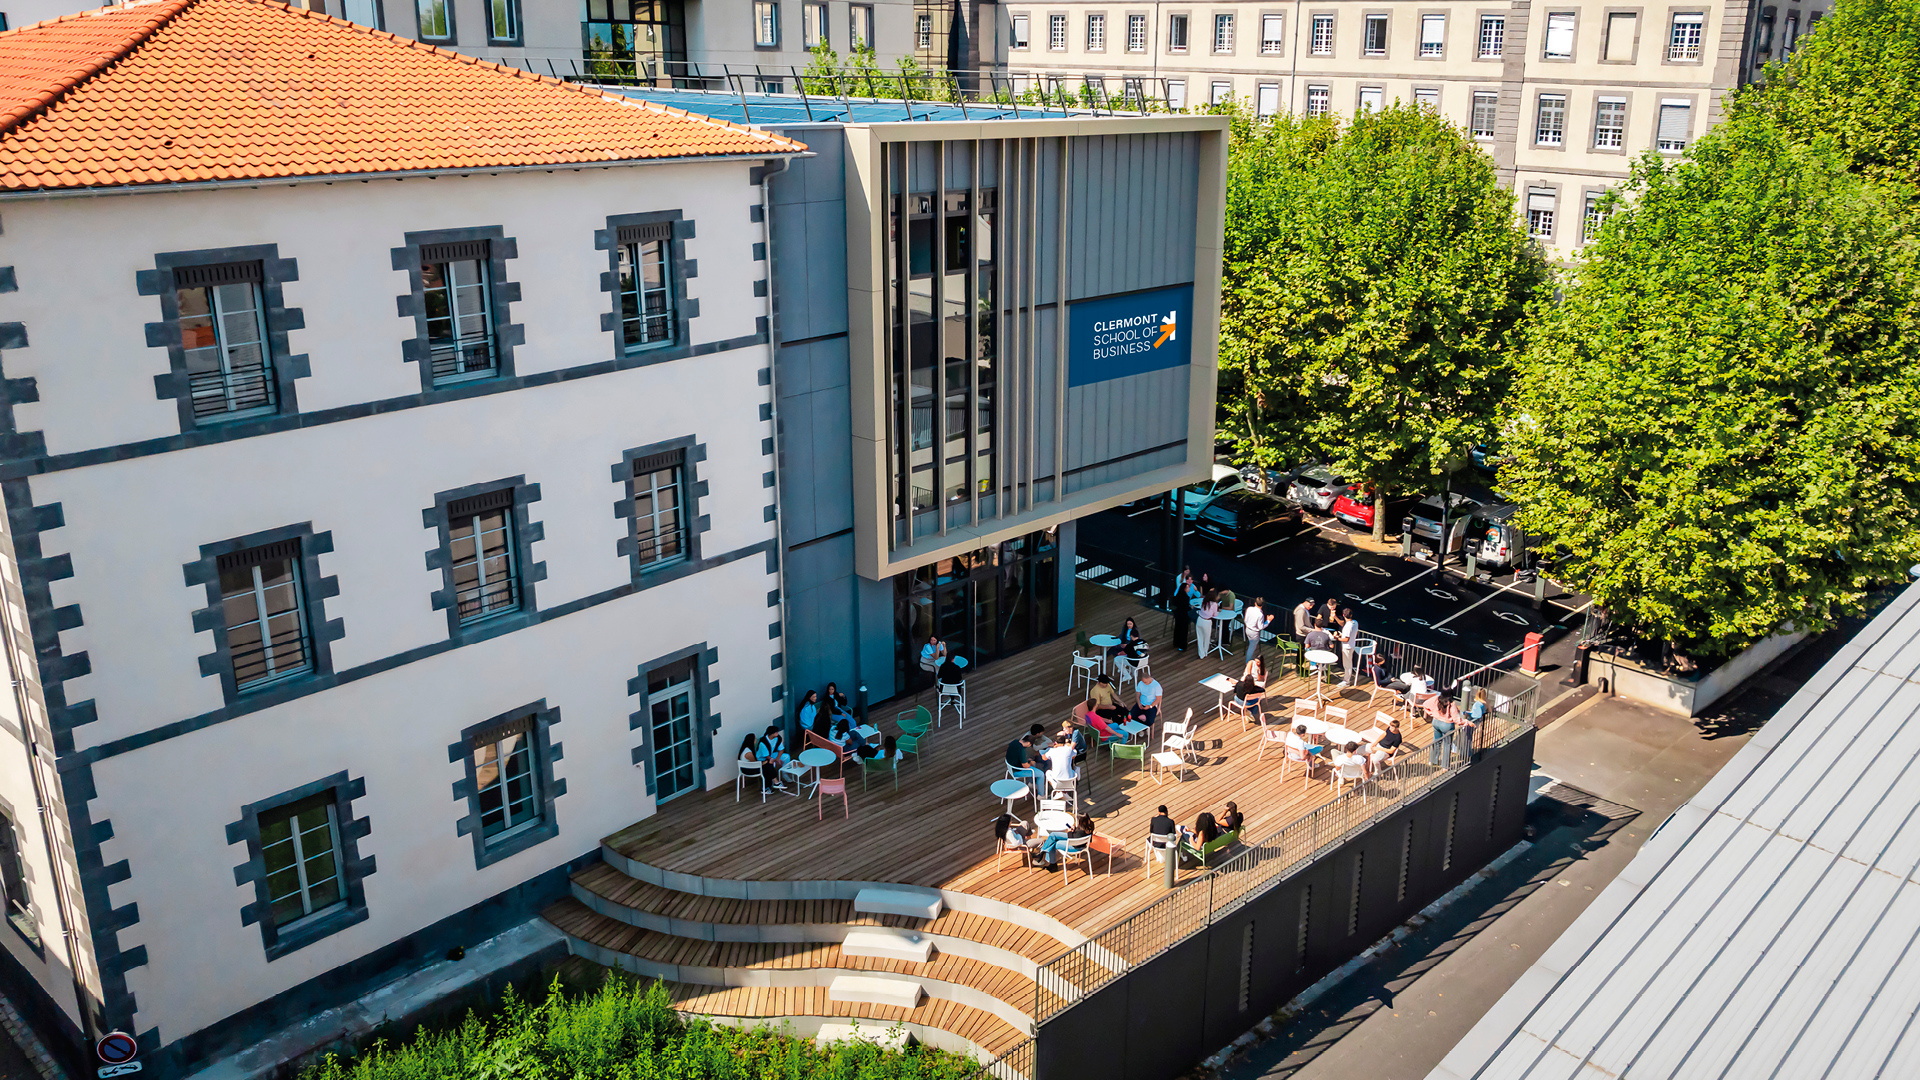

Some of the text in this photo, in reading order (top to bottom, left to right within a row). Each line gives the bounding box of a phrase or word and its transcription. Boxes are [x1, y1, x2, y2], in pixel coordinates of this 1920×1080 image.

[1094, 313, 1158, 332] CLERMONT
[1093, 325, 1158, 346] SCHOOL OF
[1093, 340, 1151, 359] BUSINESS
